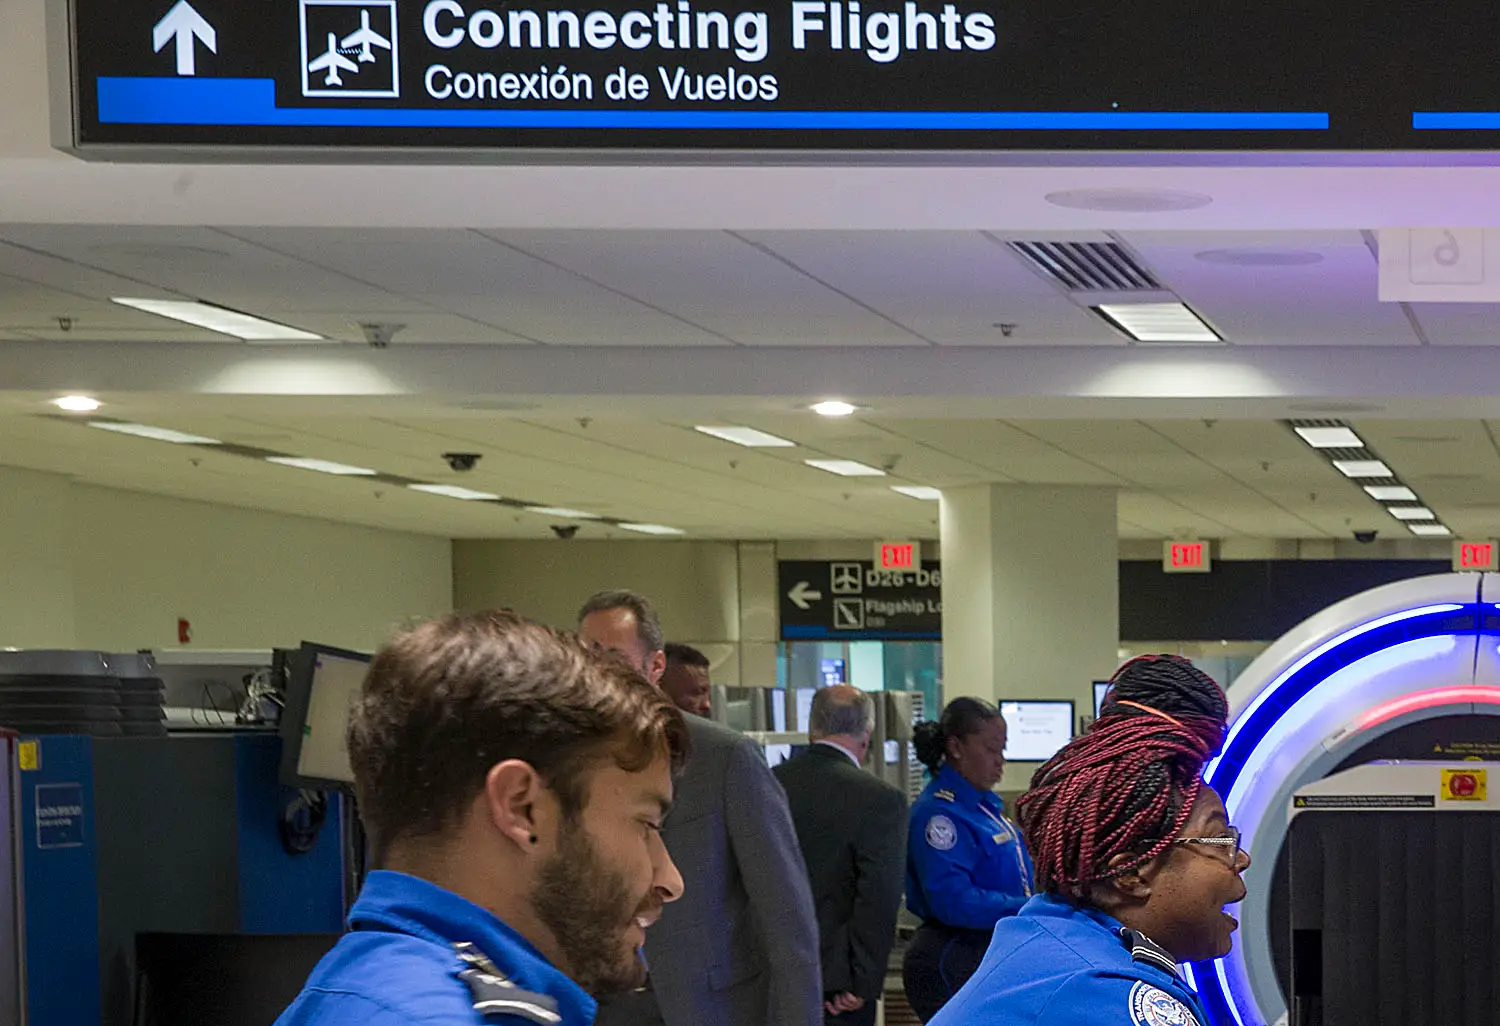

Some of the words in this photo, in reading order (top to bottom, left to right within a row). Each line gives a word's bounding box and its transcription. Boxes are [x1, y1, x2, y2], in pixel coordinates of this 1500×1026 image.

[424, 0, 767, 61] Connecting
[792, 1, 995, 62] Flights
[425, 65, 592, 99] Conexión
[605, 67, 648, 99] de
[659, 67, 778, 100] Vuelos
[882, 544, 912, 568] EXIT
[1170, 543, 1204, 568] EXIT
[1460, 543, 1493, 568] EXIT
[865, 600, 924, 616] Flagship
